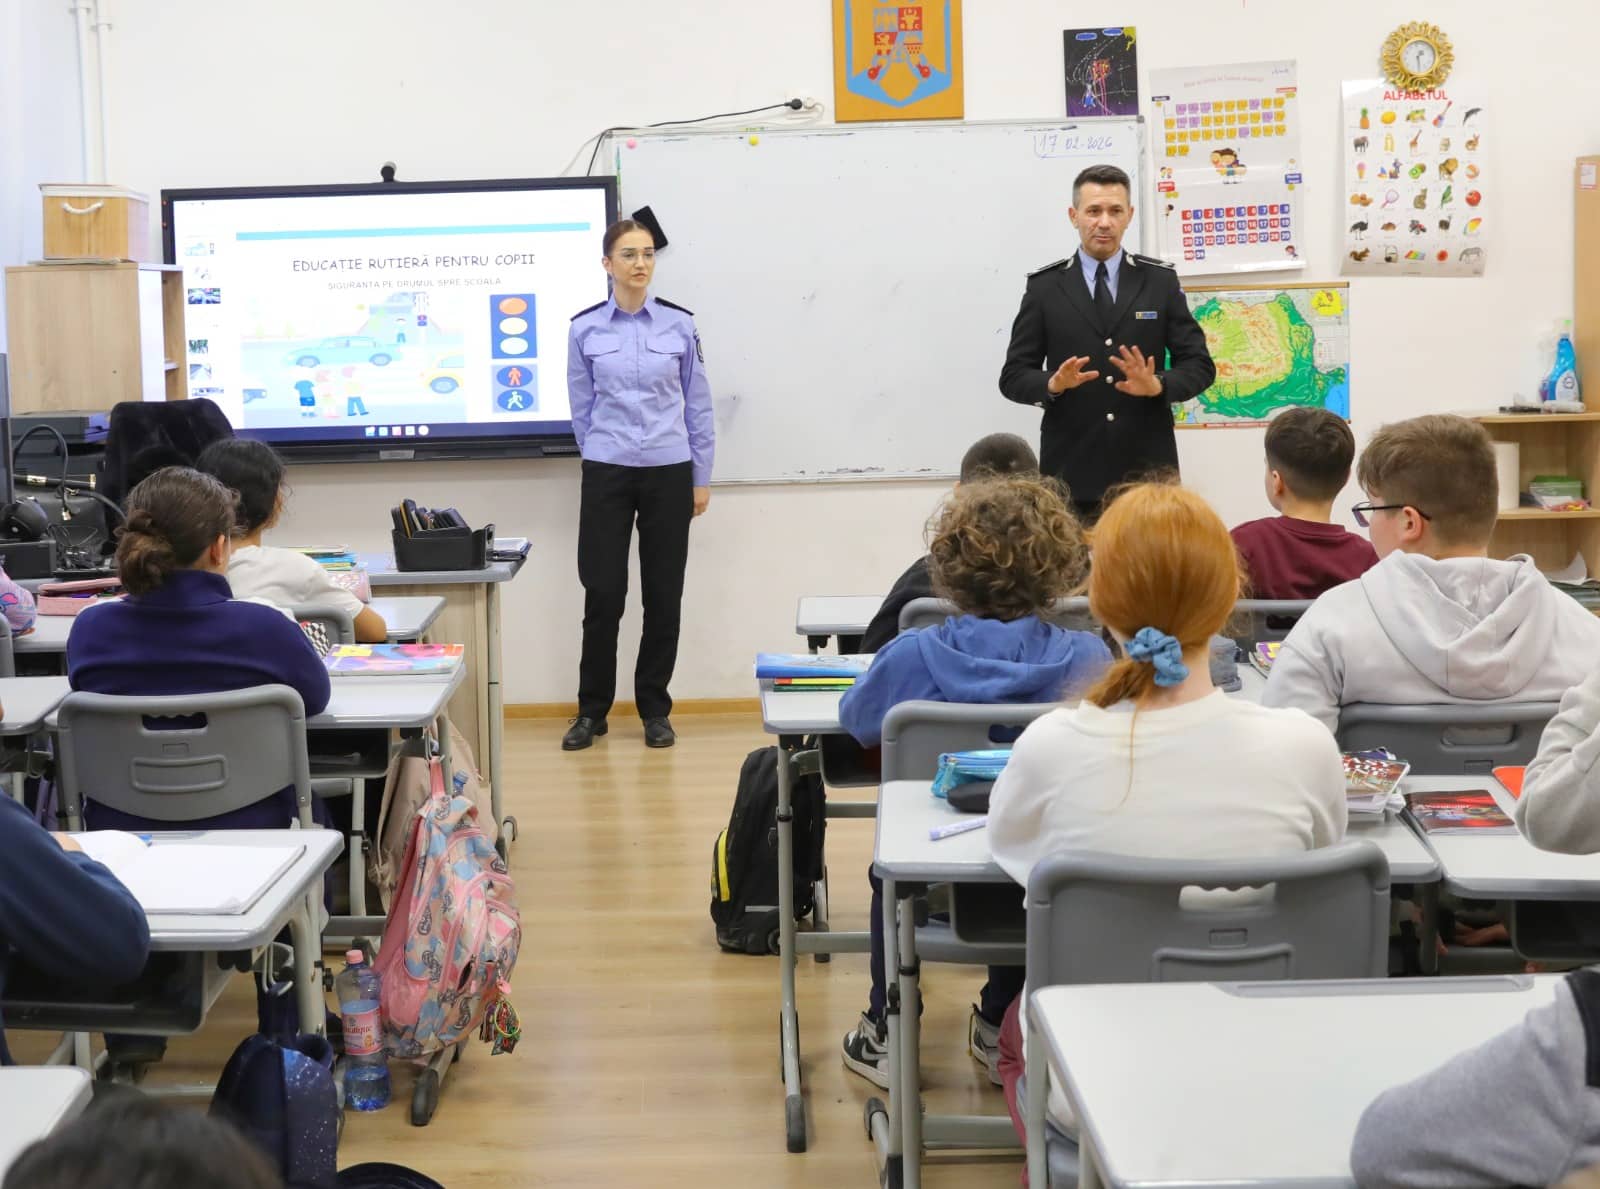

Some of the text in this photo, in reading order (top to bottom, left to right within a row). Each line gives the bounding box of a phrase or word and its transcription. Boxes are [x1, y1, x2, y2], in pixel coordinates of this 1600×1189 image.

[1384, 88, 1448, 101] ALFABETUL
[435, 255, 489, 267] PENTRU
[495, 253, 535, 266] COPII
